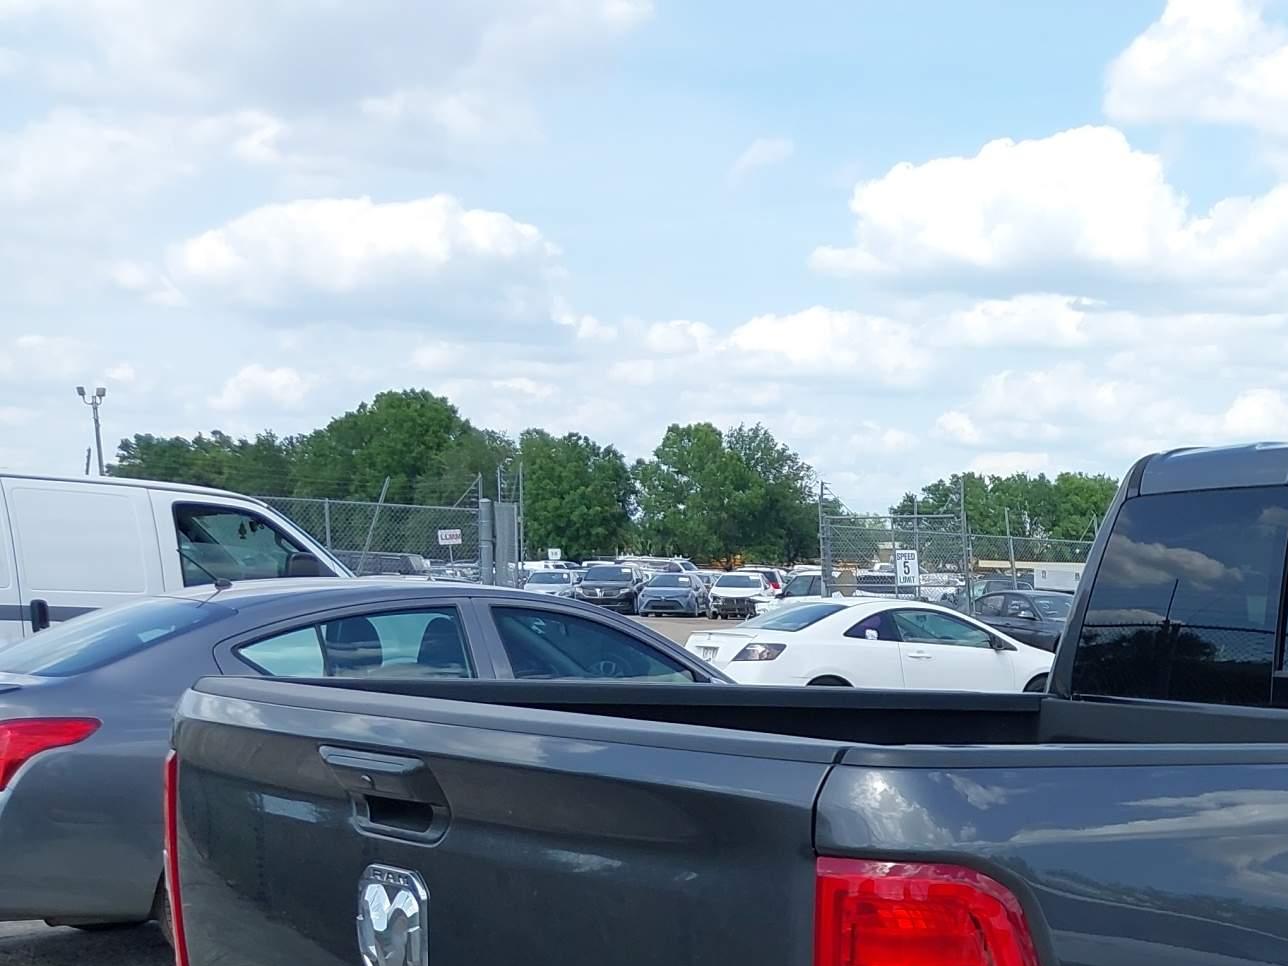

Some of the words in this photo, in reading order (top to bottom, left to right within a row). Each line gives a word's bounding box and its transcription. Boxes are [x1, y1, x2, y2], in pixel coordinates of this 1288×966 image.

[903, 561, 910, 575] 5
[900, 576, 915, 584] LIMIT
[370, 869, 409, 886] RAM
